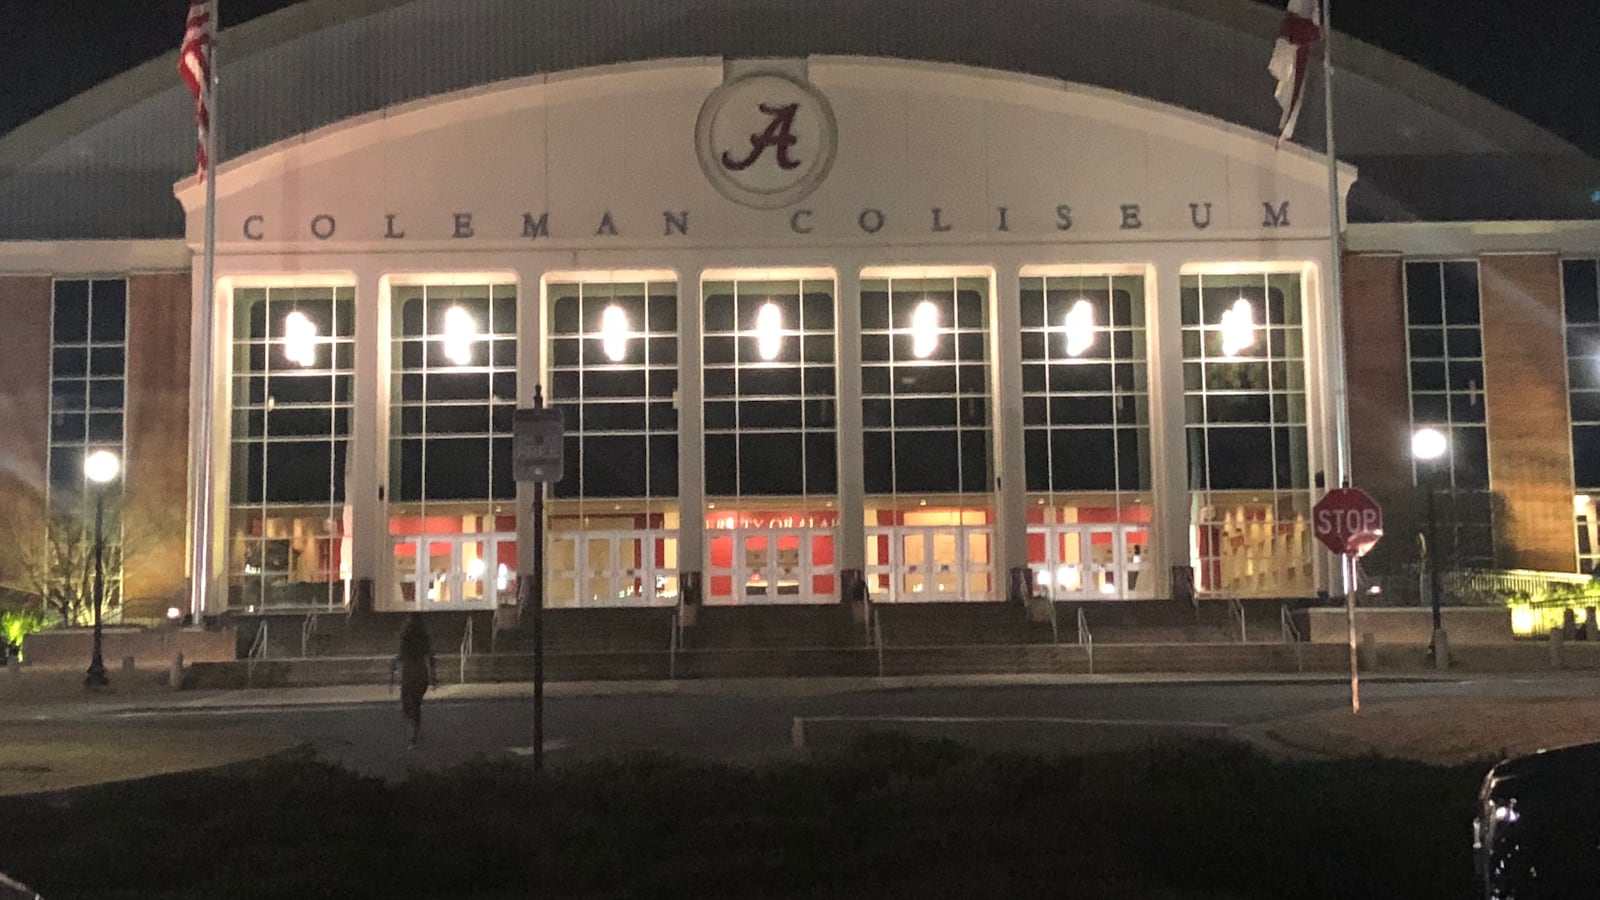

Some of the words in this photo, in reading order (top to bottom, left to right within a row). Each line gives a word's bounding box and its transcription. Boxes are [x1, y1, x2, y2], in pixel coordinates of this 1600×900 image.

[722, 103, 801, 171] A
[243, 210, 689, 241] COLEMAN
[789, 200, 1291, 234] COLISEUM
[1318, 508, 1377, 535] STOP
